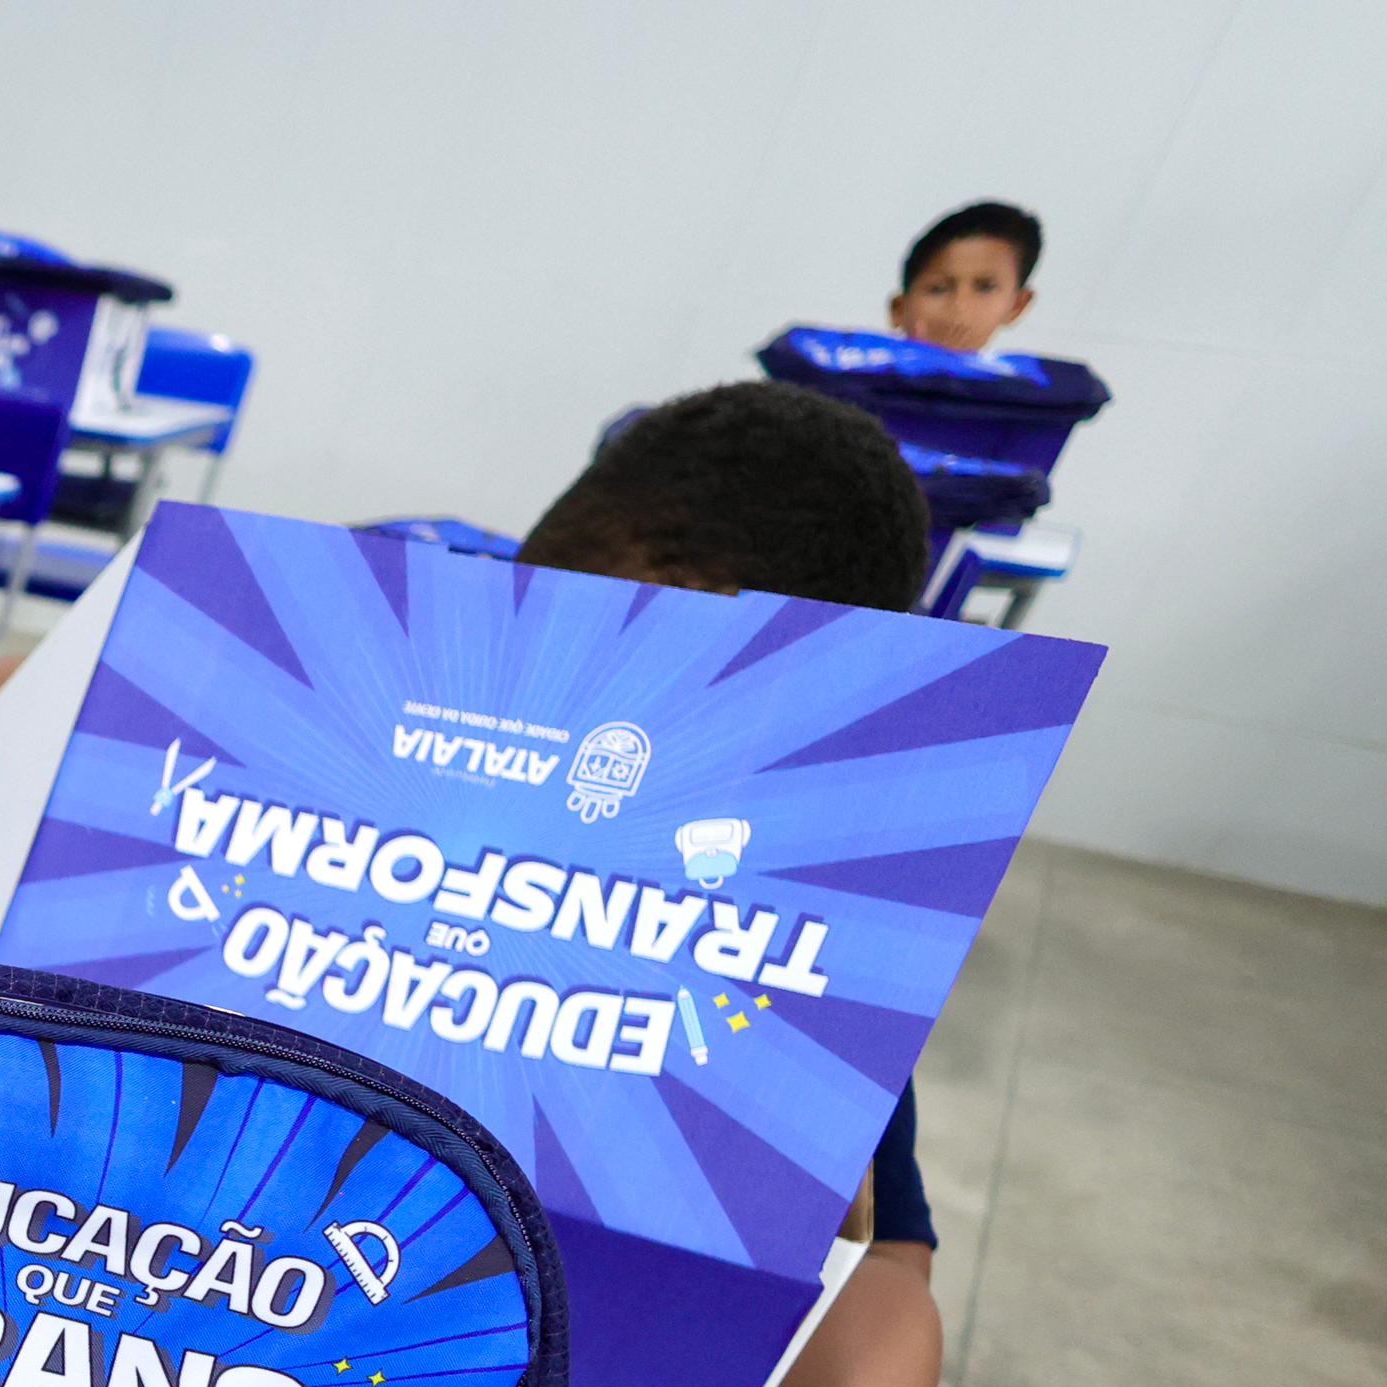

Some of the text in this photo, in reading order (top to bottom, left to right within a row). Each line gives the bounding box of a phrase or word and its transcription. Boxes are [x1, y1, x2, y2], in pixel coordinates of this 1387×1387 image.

[442, 707, 460, 722] DA
[497, 716, 524, 735] QUE
[393, 724, 560, 786] ATALAIA
[173, 787, 830, 998] TRANSFORMA
[427, 921, 491, 957] QUE
[223, 907, 676, 1077] EDUCAÇÃO
[15, 1263, 121, 1318] QUE
